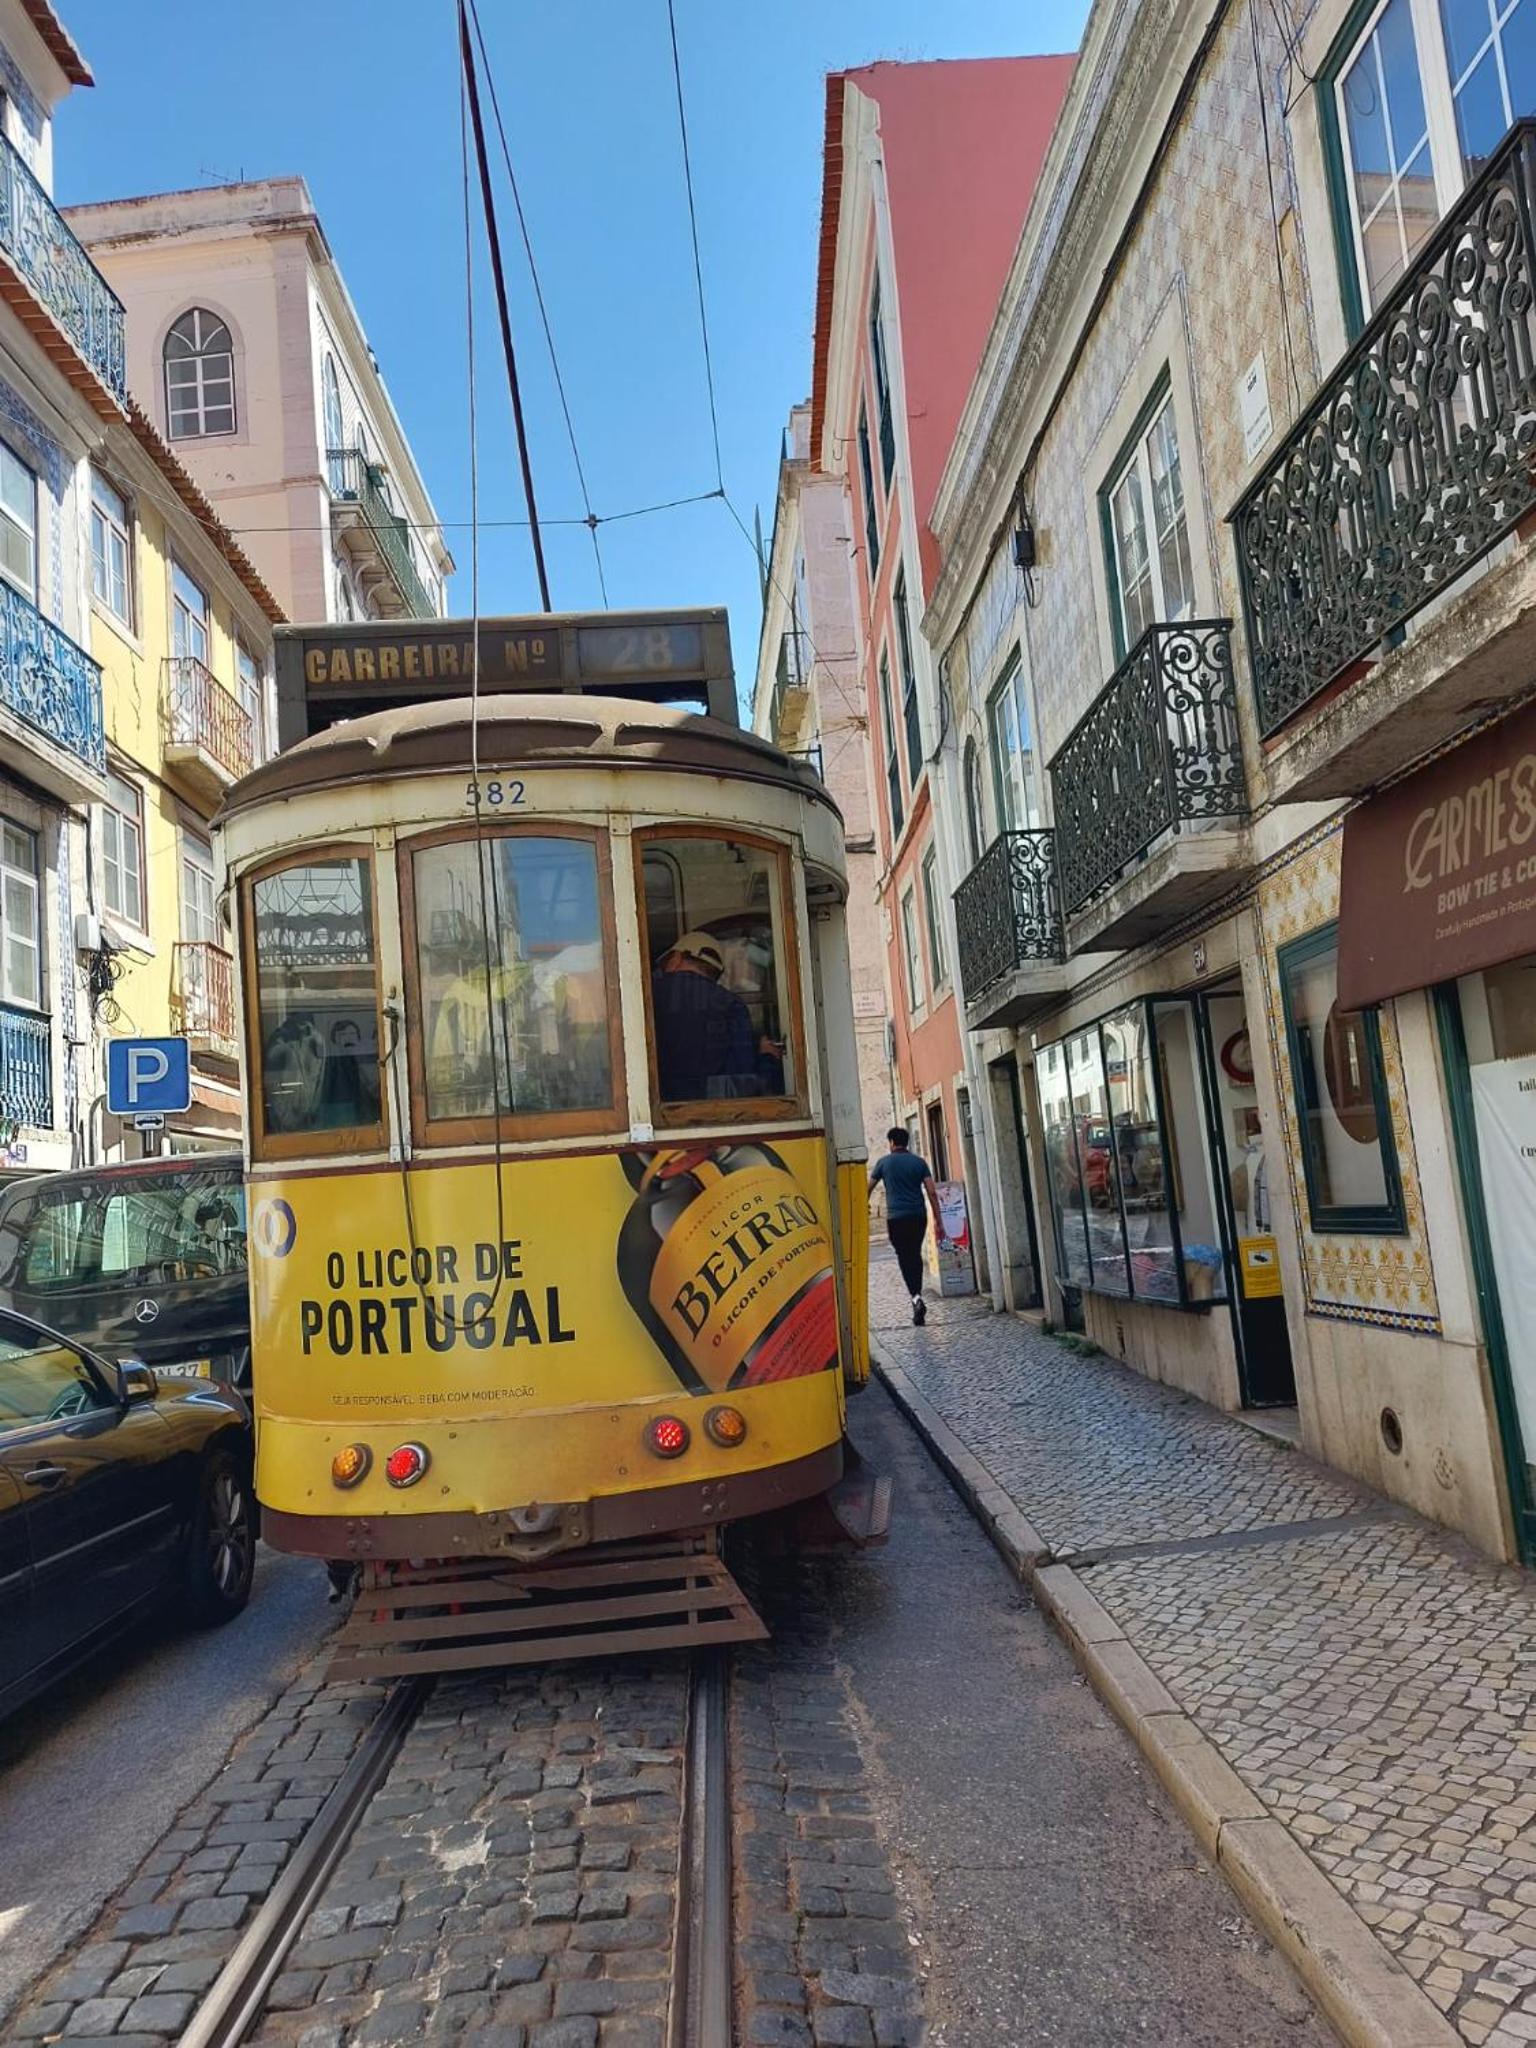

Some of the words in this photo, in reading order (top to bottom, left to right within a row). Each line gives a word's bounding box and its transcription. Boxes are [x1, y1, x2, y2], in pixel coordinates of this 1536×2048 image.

[304, 640, 484, 685] CARREIRA
[609, 628, 674, 674] 28
[465, 780, 527, 807] 582
[1437, 881, 1472, 915] BOW
[1474, 871, 1499, 899] TIE
[1501, 866, 1513, 890] &
[127, 1047, 170, 1104] P
[710, 1195, 765, 1238] LICOR
[326, 1250, 346, 1290] O
[357, 1245, 458, 1289] LICOR
[475, 1239, 525, 1284] DE
[670, 1192, 819, 1343] BEIRÃO
[712, 1333, 723, 1349] O
[721, 1286, 760, 1335] LICOR
[758, 1266, 777, 1288] DE
[776, 1236, 828, 1271] PORTUGAL
[301, 1286, 576, 1356] PORTUGAL
[446, 1391, 472, 1403] COM
